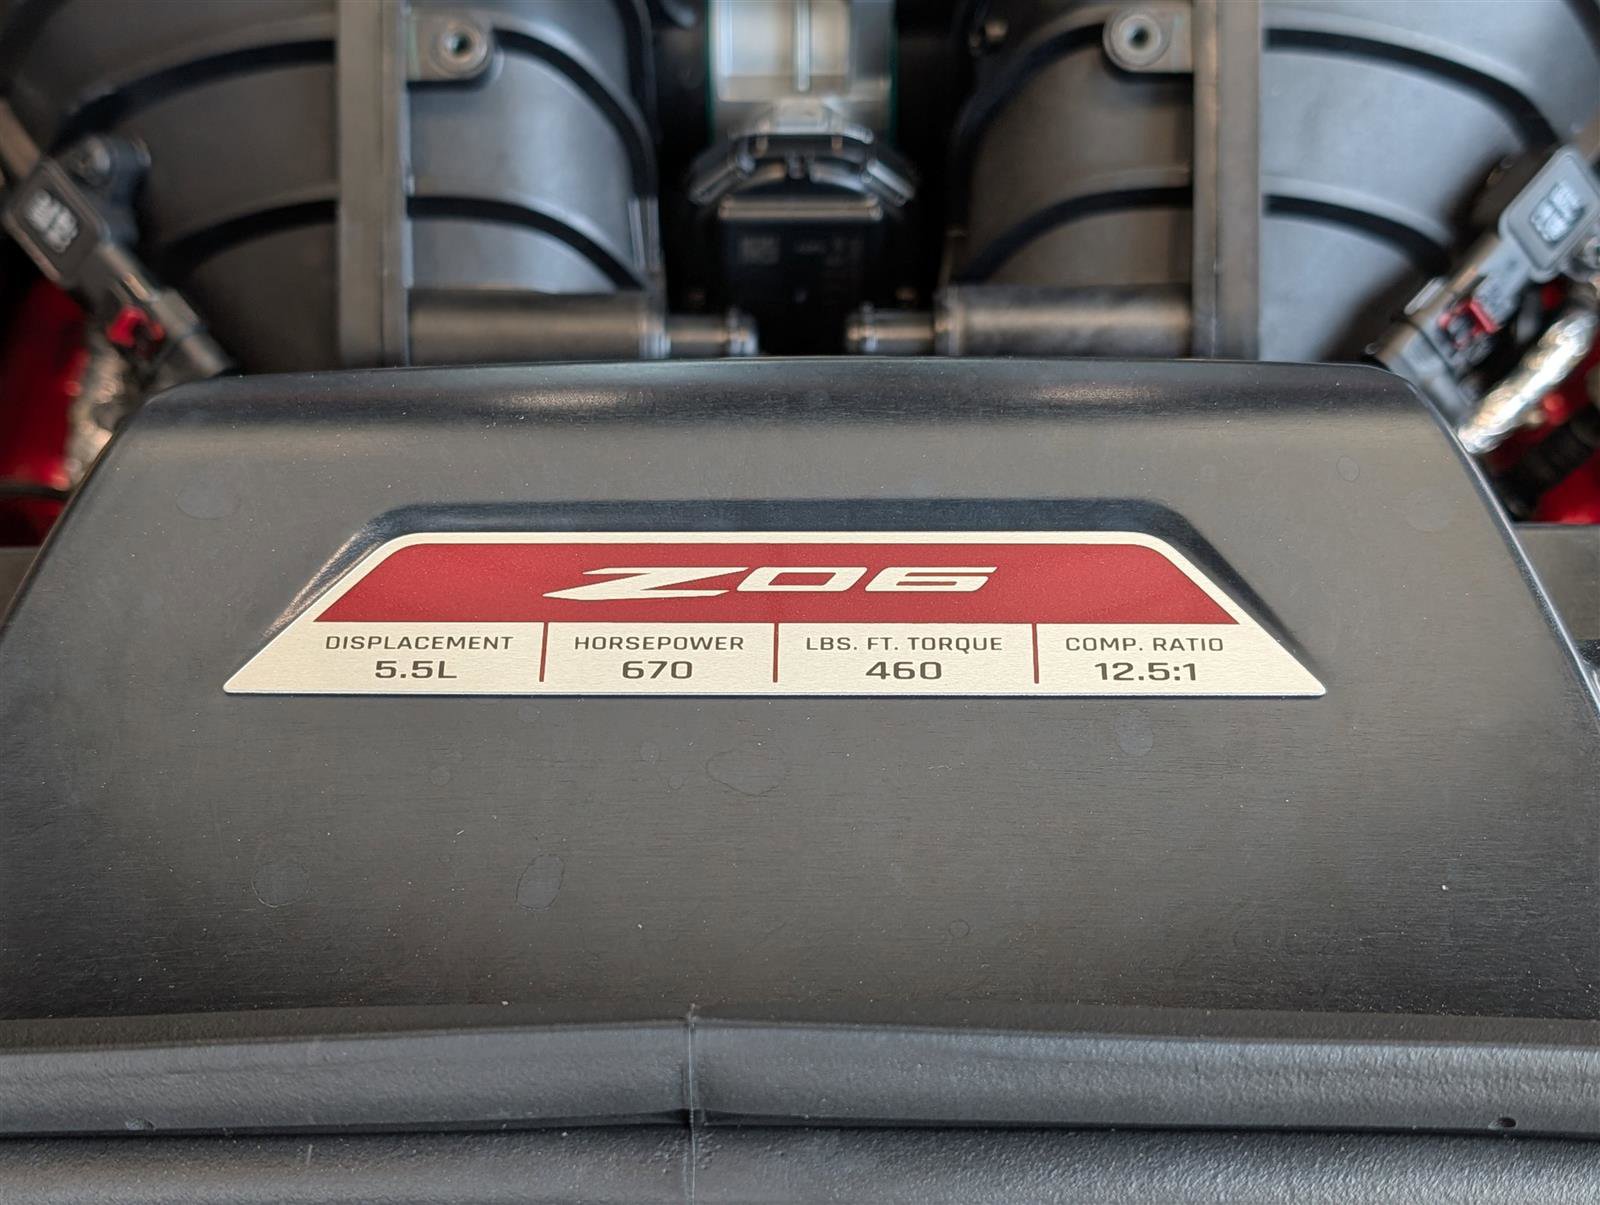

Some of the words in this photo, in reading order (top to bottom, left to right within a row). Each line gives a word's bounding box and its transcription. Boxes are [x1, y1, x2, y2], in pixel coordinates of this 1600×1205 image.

[325, 636, 514, 651] DISPLACEMENT
[574, 636, 744, 651] HORSEPOWER
[805, 637, 858, 651] LBS.
[867, 637, 900, 651] FT.
[907, 637, 1003, 653] TORQUE
[1065, 637, 1144, 652] COMP.
[1152, 637, 1225, 652] RATIO
[374, 660, 457, 680] 5.5L
[622, 660, 693, 680] 670
[865, 661, 943, 681] 460
[1094, 662, 1198, 682] 12.5:1
